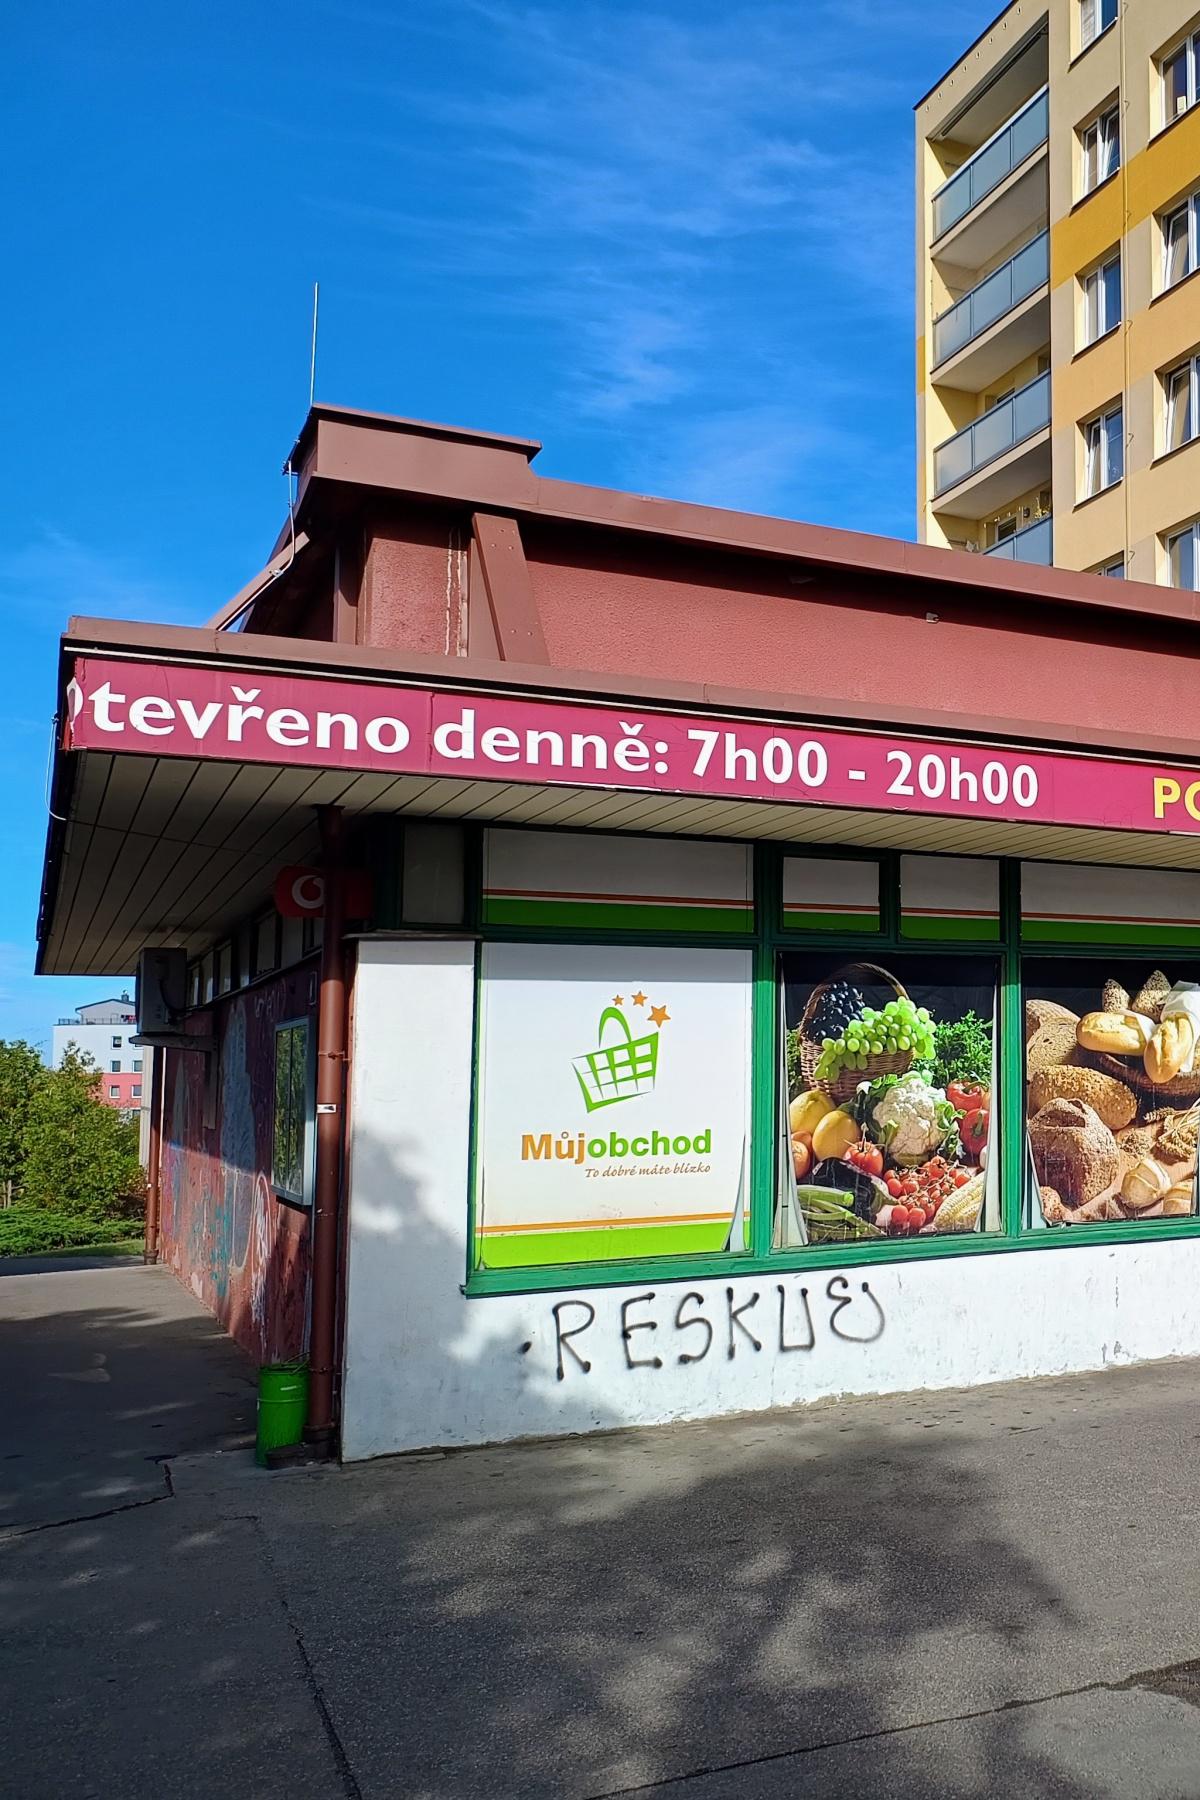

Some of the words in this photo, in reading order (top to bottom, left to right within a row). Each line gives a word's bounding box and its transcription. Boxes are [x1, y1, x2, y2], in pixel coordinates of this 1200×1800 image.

[433, 708, 670, 777] denně:
[687, 728, 829, 788] 7h00
[848, 770, 867, 782] -
[886, 750, 1040, 809] 20h00
[520, 1128, 712, 1165] Můjobchod
[584, 1167, 600, 1178] To
[602, 1164, 638, 1178] dobré
[638, 1164, 672, 1176] máte
[672, 1162, 712, 1175] blízko
